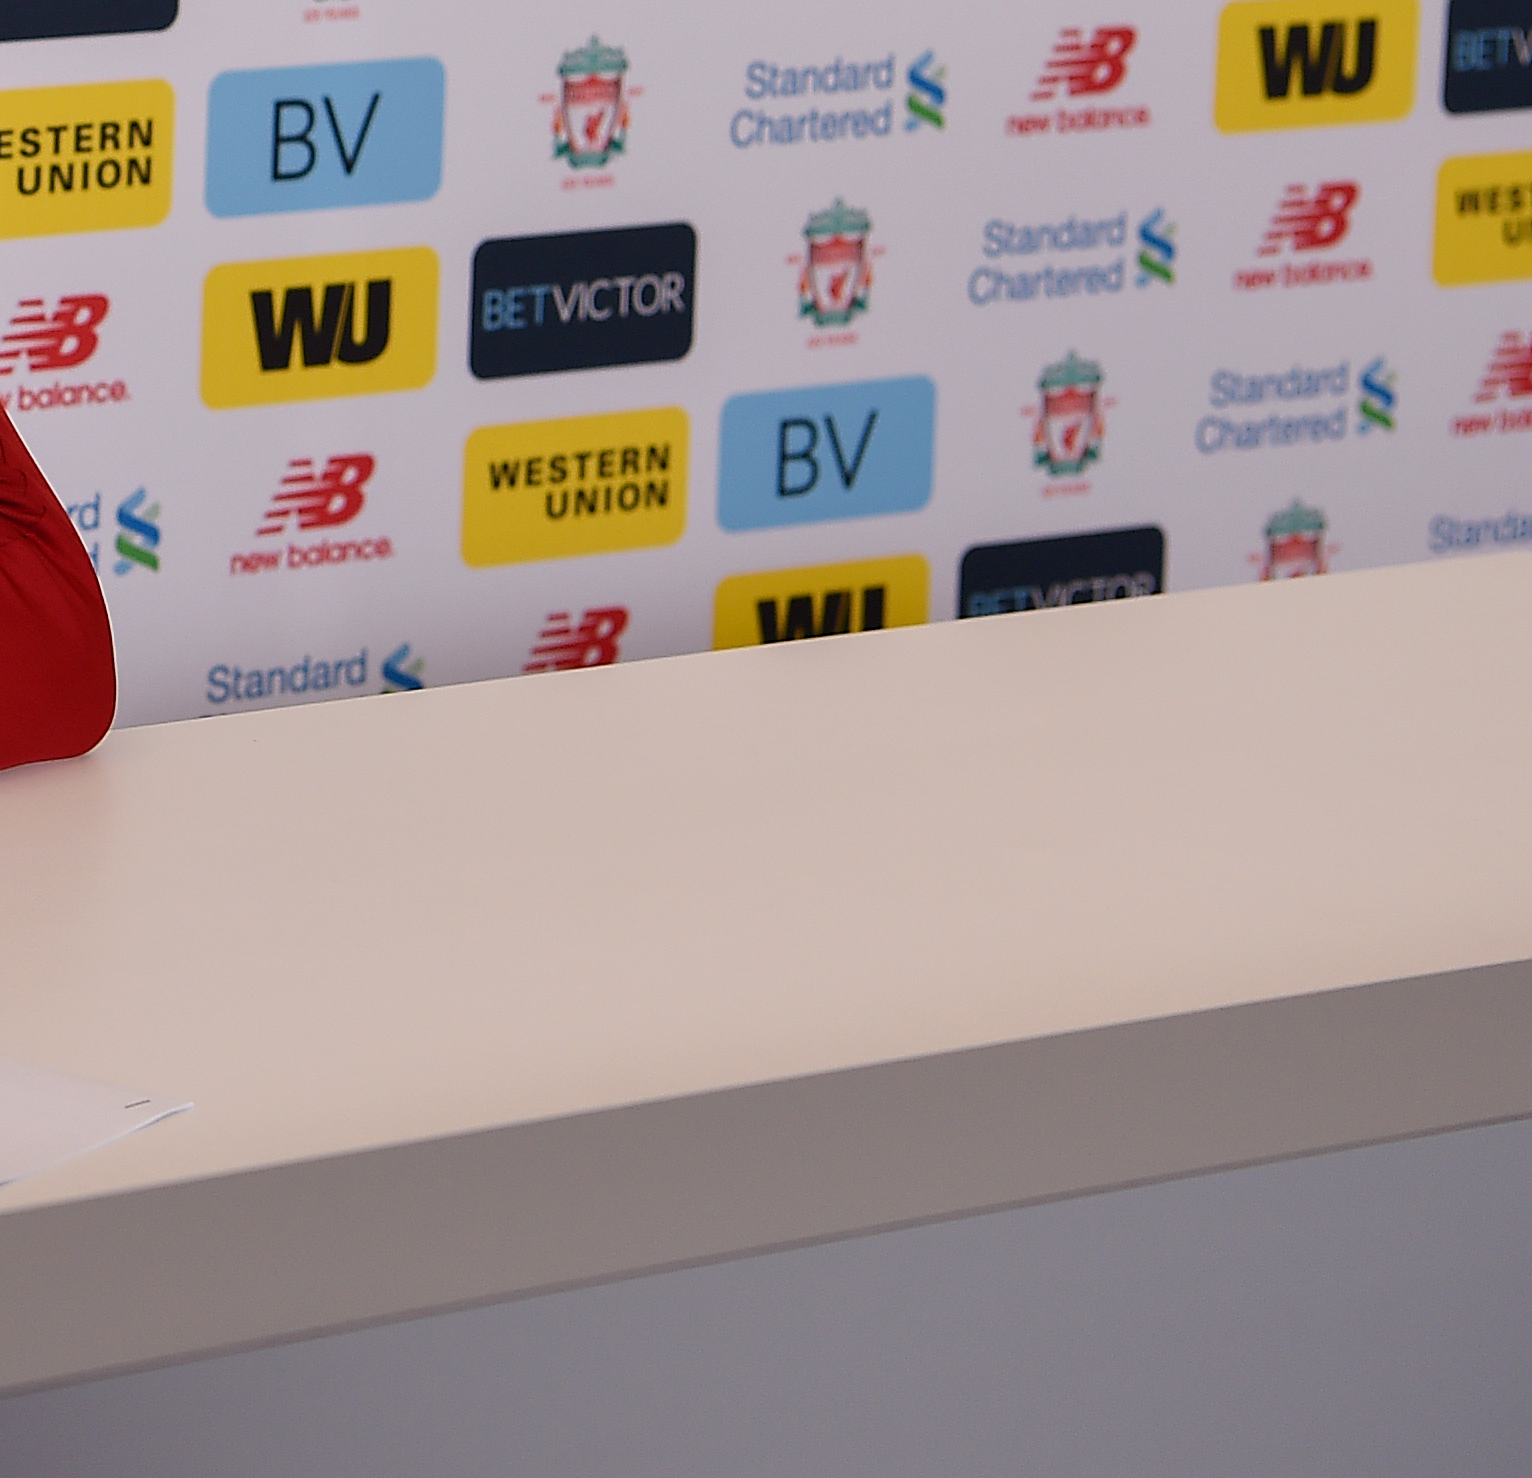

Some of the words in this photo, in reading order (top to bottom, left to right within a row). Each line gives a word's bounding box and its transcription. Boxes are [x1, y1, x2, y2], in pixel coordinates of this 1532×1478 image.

[1259, 19, 1376, 99] WU
[271, 93, 379, 182] BV
[18, 157, 151, 195] UNION
[250, 279, 392, 372] WU
[483, 271, 685, 330] BETVICTOR
[490, 445, 669, 490] WESTERN
[776, 411, 877, 498] BV
[546, 481, 668, 519] UNION
